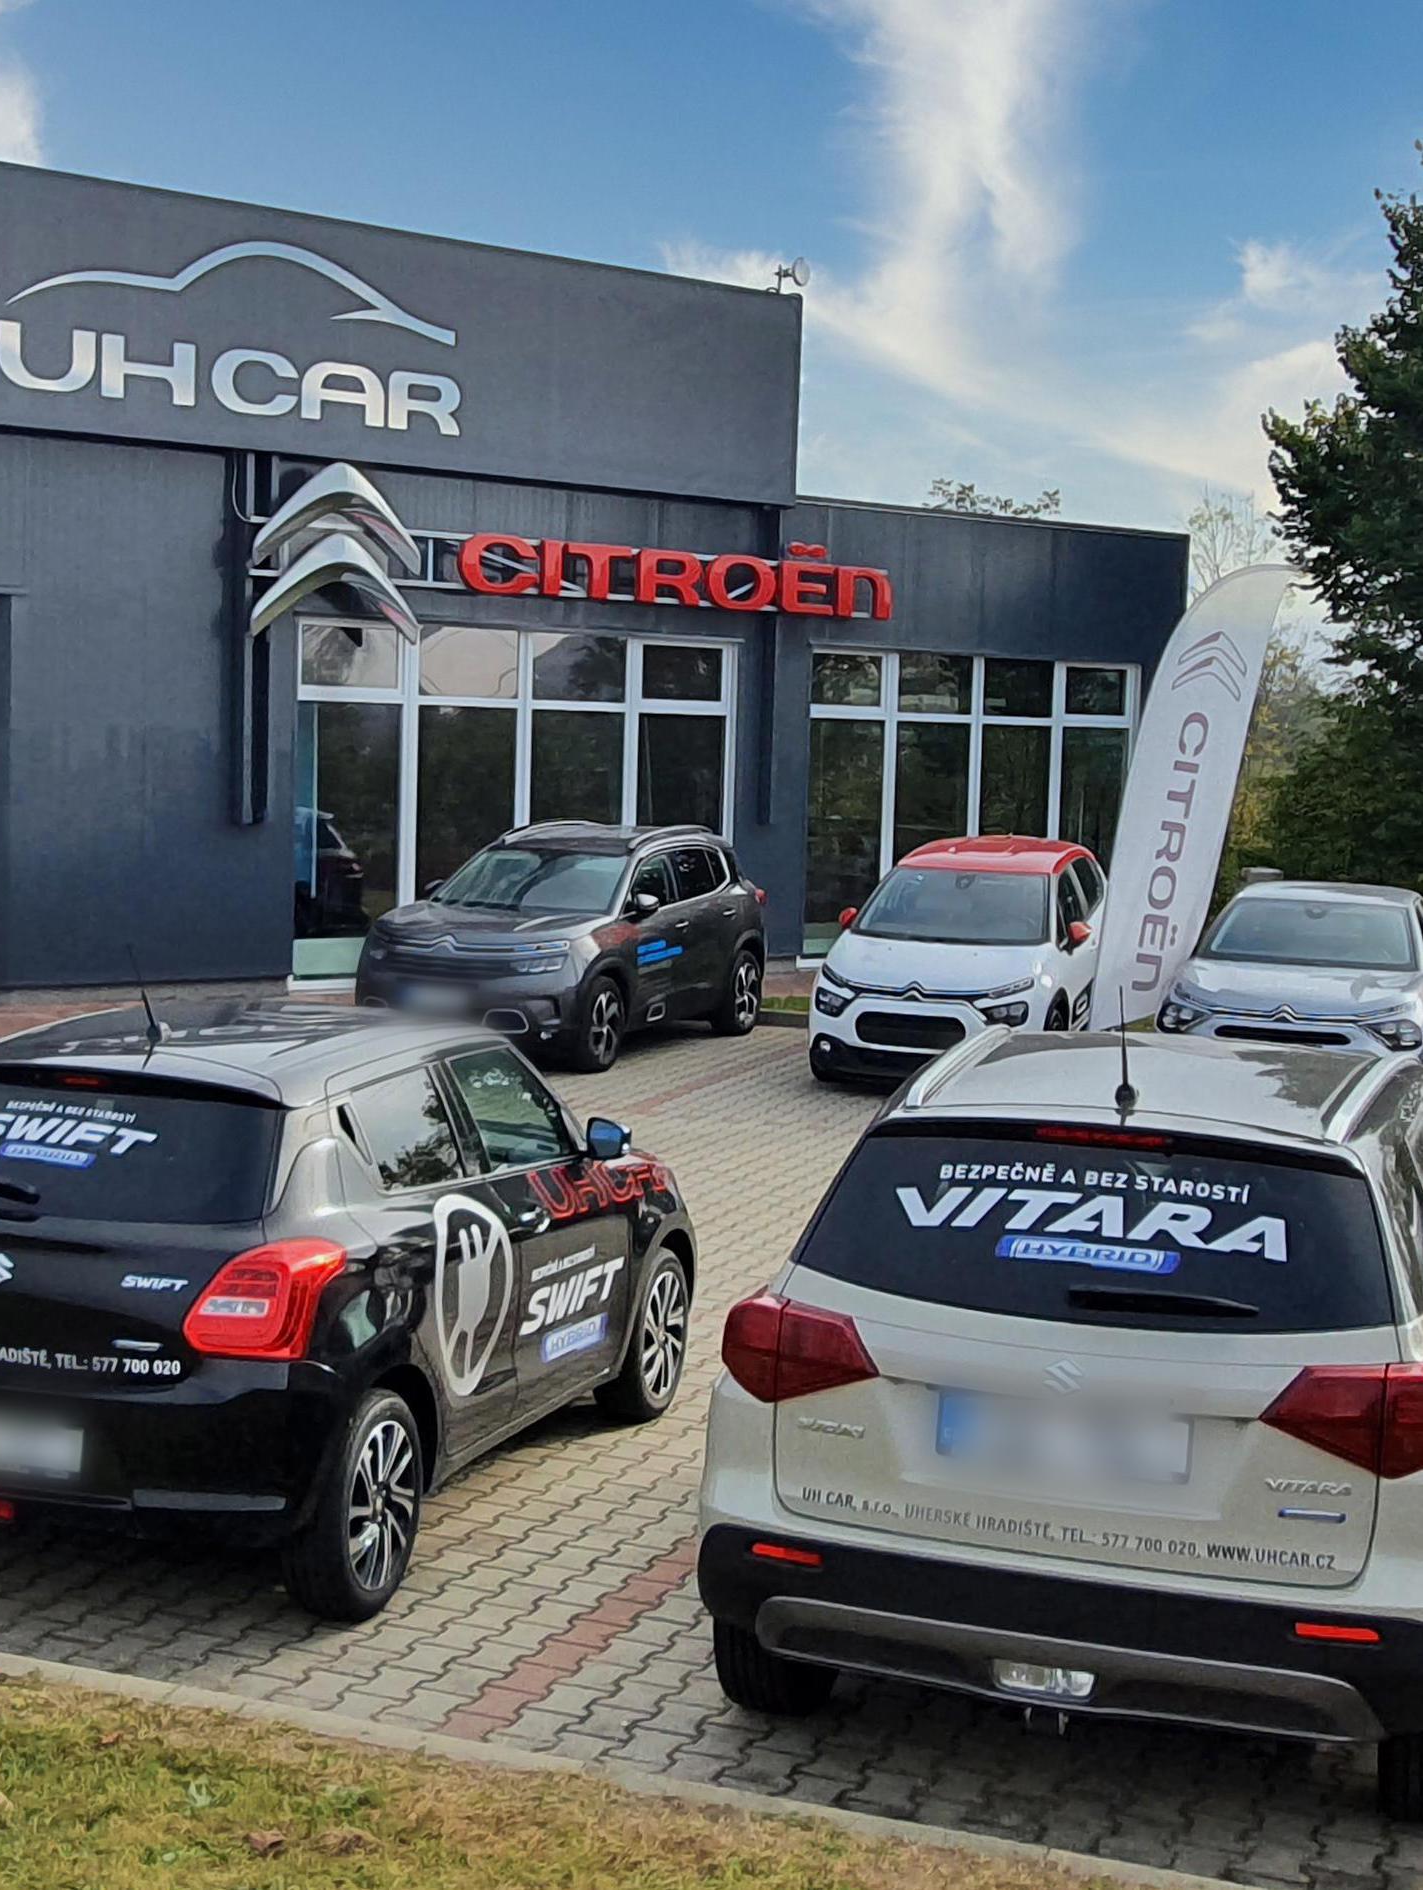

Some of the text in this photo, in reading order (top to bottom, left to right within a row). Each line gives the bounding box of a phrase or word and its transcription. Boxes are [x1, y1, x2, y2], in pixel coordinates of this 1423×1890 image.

[458, 533, 893, 620] CITROËN
[939, 1161, 1250, 1205] BEZPEČNĚ A BEZ STAROSTÍ
[895, 1187, 1288, 1263] VITARA
[1020, 1241, 1155, 1265] HYBRID
[121, 1274, 189, 1291] SWIFT
[519, 1256, 625, 1336] SWIFT
[92, 1356, 118, 1373] 577
[123, 1359, 149, 1374] 700
[152, 1360, 181, 1376] 020
[1265, 1476, 1353, 1497] VITARA
[802, 1486, 821, 1505] UH
[826, 1492, 857, 1512] CAR,
[904, 1503, 972, 1527] UHERSKÉ
[1101, 1532, 1129, 1549] 577
[1135, 1536, 1162, 1553] 700
[1168, 1538, 1201, 1559] 020,
[1206, 1543, 1337, 1570] WWW.UHCAR.CZ
